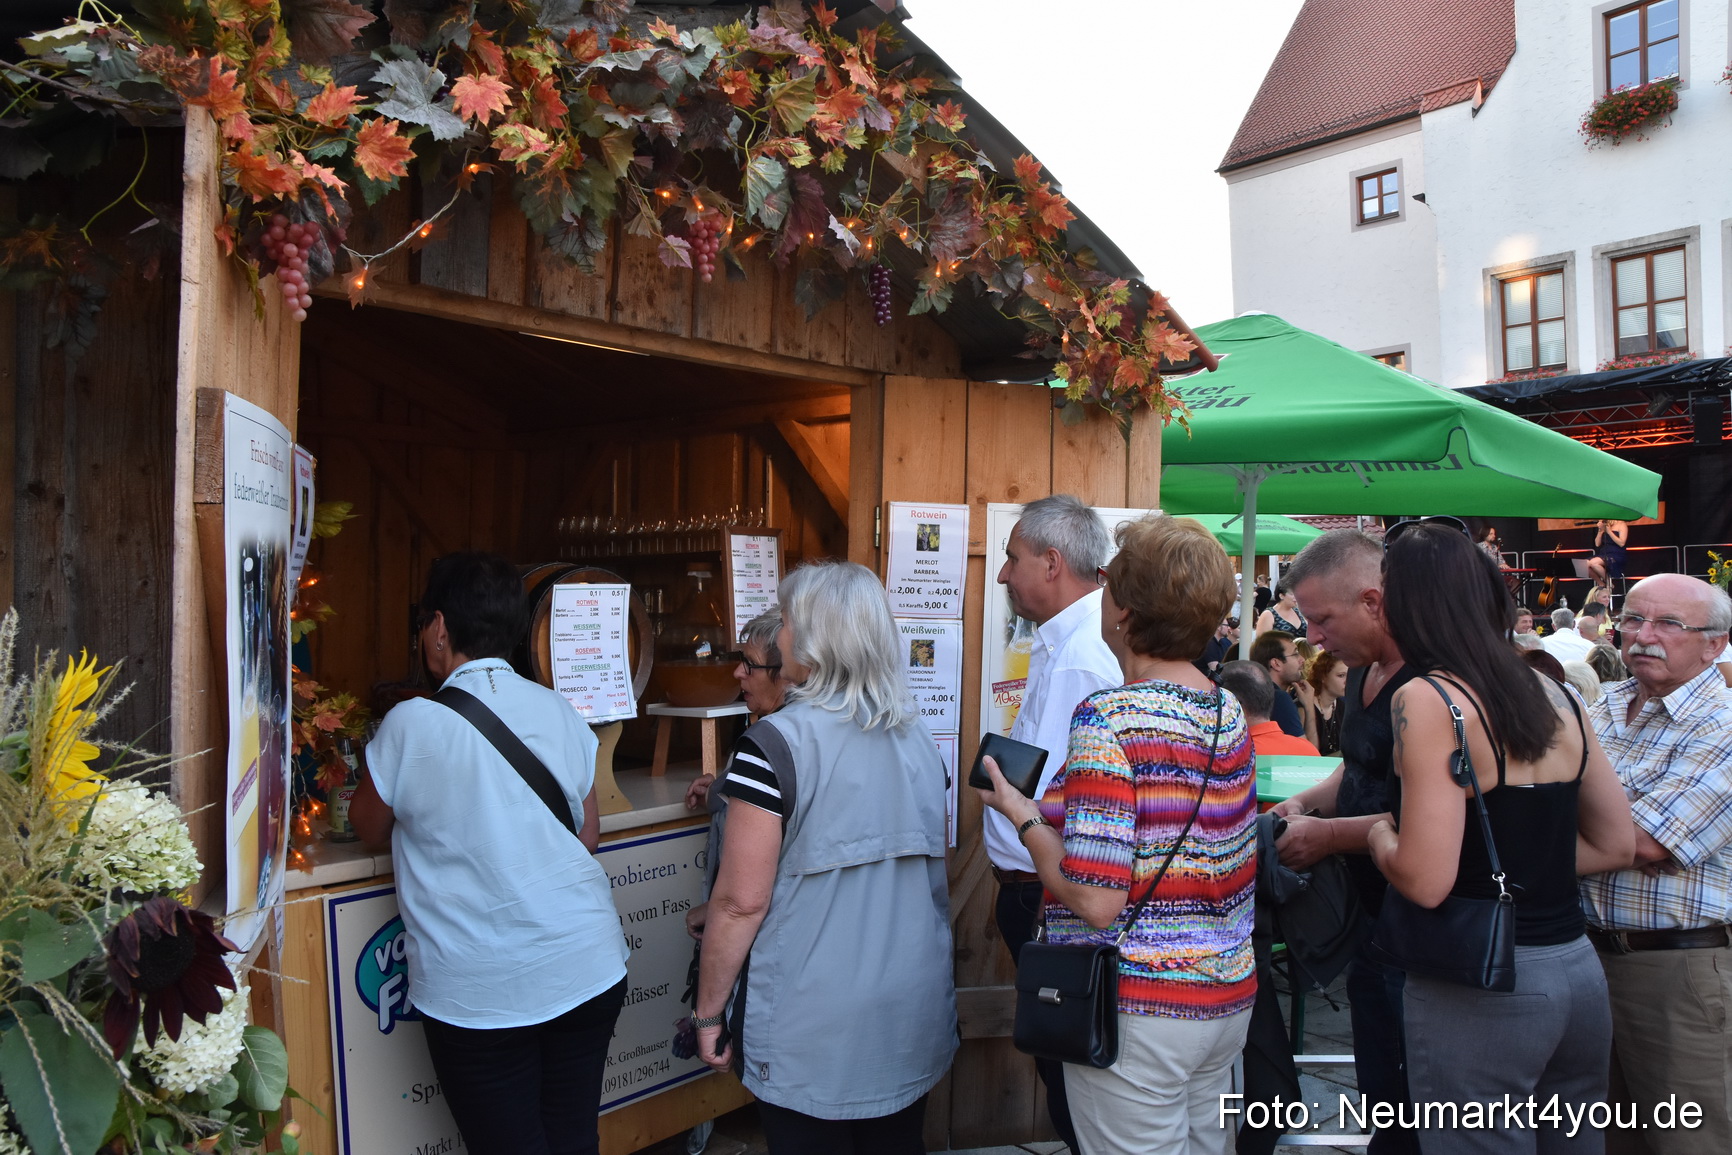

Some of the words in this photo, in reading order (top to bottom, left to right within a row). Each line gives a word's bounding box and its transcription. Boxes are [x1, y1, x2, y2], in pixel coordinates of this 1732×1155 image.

[911, 509, 947, 519] Rotwein
[897, 587, 915, 595] 2,00
[935, 588, 952, 596] 4,00
[901, 625, 945, 634] Weißwein
[571, 663, 611, 672] FEDERWEISSER
[921, 708, 938, 716] 9,00
[627, 906, 658, 924] vom
[661, 897, 691, 916] Fass
[618, 1039, 669, 1063] Großhauser
